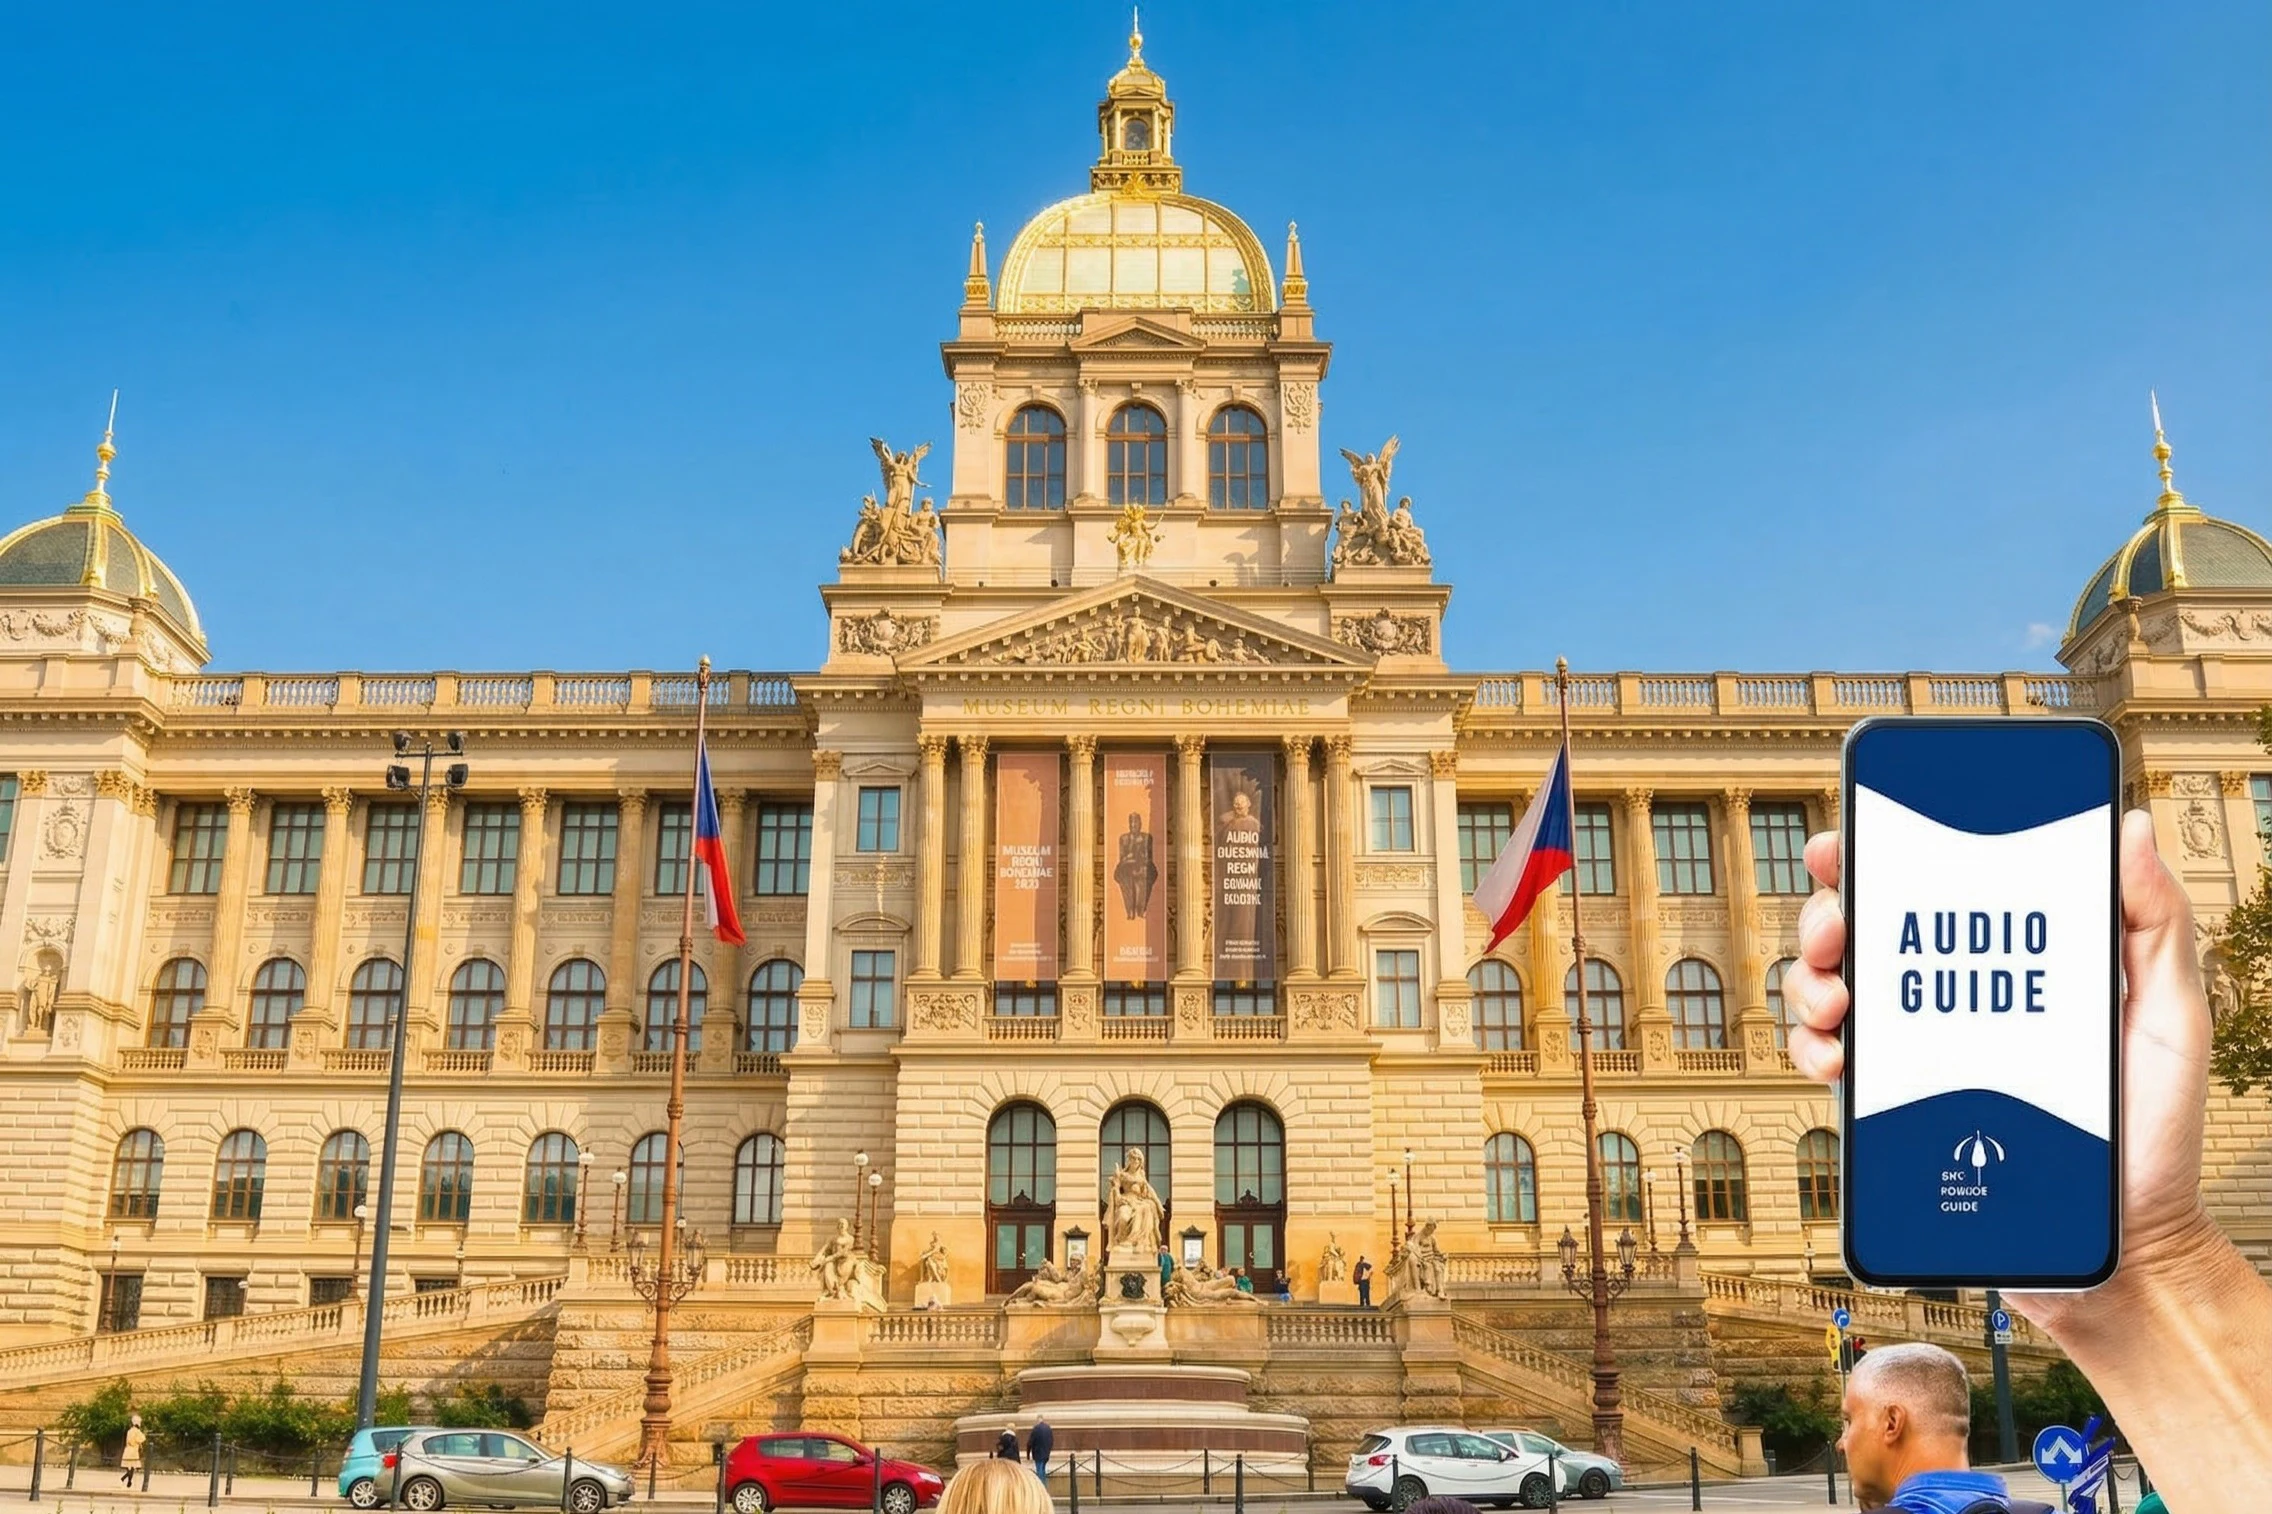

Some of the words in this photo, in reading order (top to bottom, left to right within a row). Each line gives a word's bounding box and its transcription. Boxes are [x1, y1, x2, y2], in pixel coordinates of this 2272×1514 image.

[963, 698, 1068, 715] MUSEUM
[1089, 698, 1165, 715] REGNI
[1182, 698, 1311, 715] BOHEMIAE
[1899, 911, 2047, 954] AUDIO
[1901, 969, 2045, 1013] GUIDE
[1941, 1201, 1978, 1212] GUIDE
